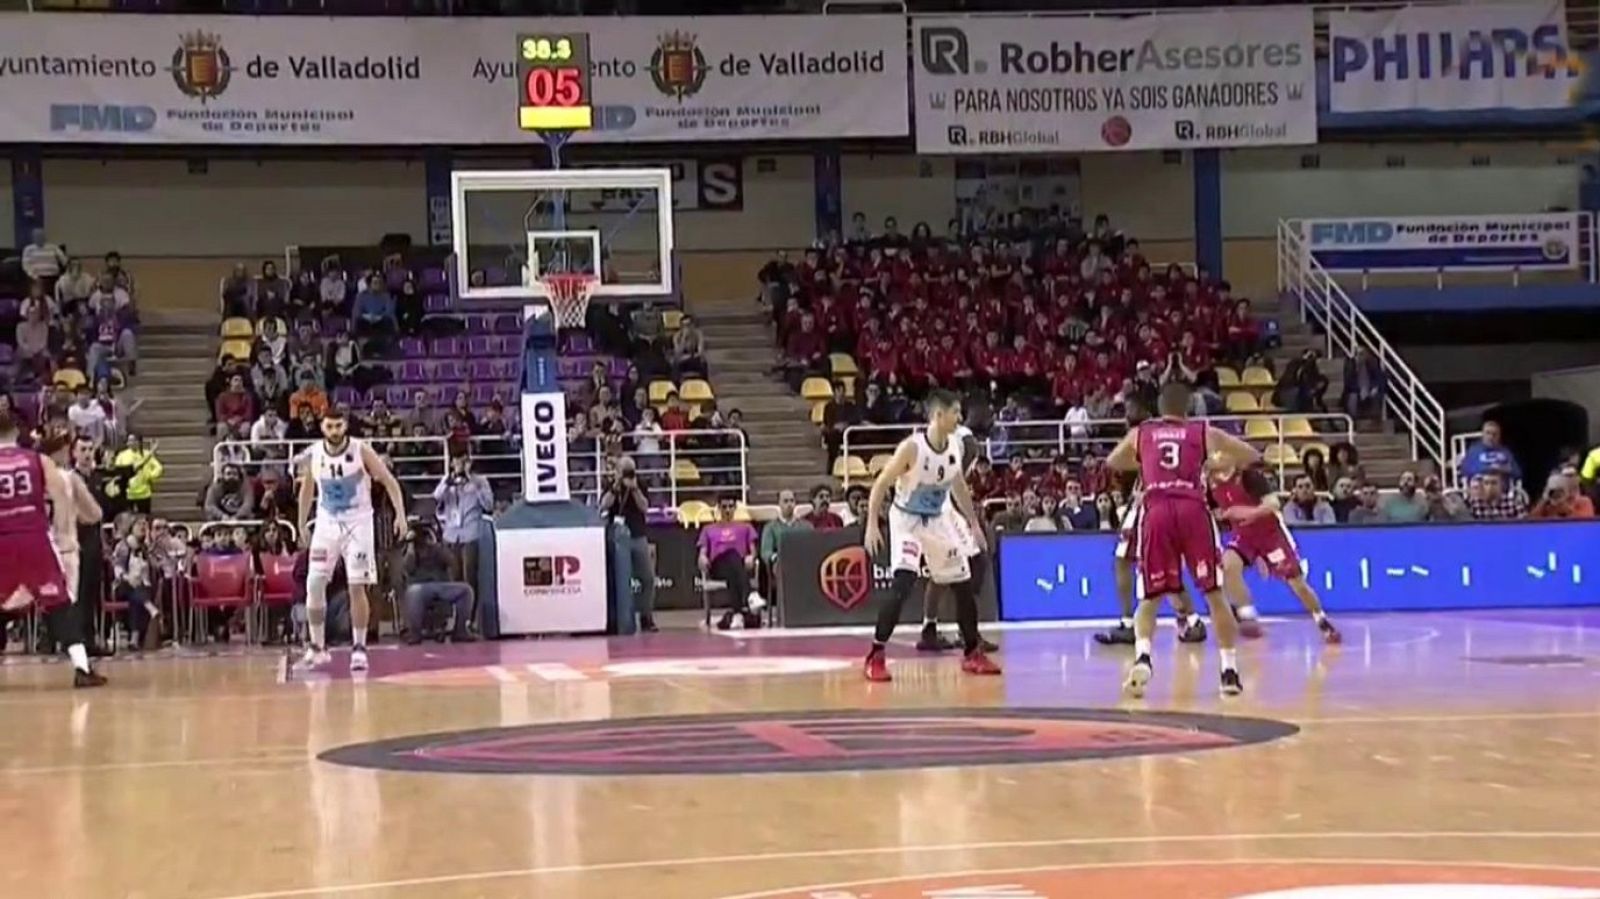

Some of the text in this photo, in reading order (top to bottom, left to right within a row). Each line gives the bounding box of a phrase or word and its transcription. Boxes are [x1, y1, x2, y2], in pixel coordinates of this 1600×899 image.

[246, 55, 279, 80] de
[287, 56, 421, 81] Valladolid
[719, 54, 751, 77] de
[759, 50, 885, 78] Valladolid
[1001, 39, 1302, 75] RobherAsesores
[527, 67, 581, 107] 05
[953, 82, 1280, 114] PARA NOSOTROS YA SOIS GANADORES
[50, 104, 157, 132] FMD
[1311, 221, 1394, 245] FMD
[1427, 232, 1540, 245] de Deportes
[1485, 220, 1571, 233] Municipal
[534, 401, 558, 493] IVECO
[1157, 441, 1180, 470] 3
[0, 469, 32, 499] 33
[329, 463, 344, 479] 14
